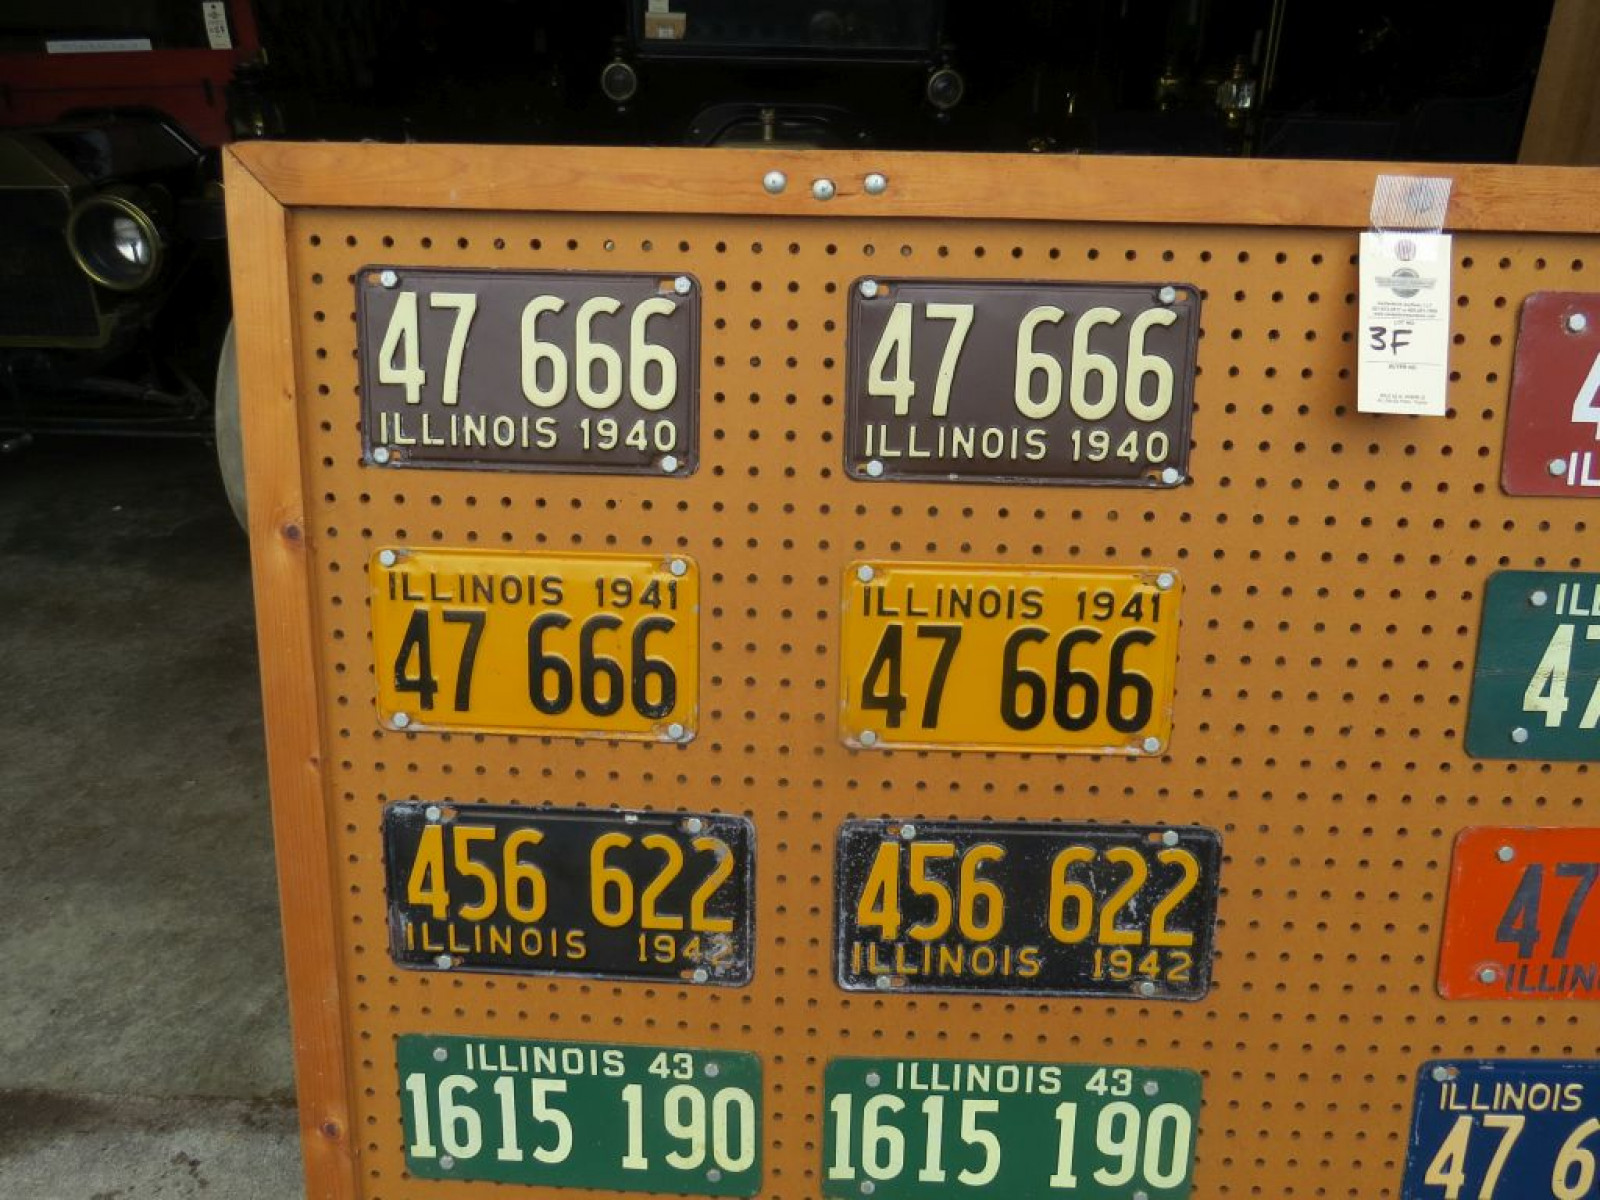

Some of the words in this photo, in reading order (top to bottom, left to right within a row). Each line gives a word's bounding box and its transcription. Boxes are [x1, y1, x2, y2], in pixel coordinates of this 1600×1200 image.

[379, 291, 478, 405] 47
[521, 295, 678, 411] 666
[867, 302, 975, 417] 47
[1014, 305, 1178, 422] 666
[1369, 326, 1413, 356] 3F
[380, 412, 558, 449] ILLINOIS
[580, 417, 678, 452] 1940
[865, 425, 1048, 461] ILLINOIS
[1071, 430, 1170, 464] 1940
[389, 572, 564, 606] ILLINOIS
[595, 578, 678, 610] 1941
[863, 586, 1045, 620] ILLINOIS
[1077, 591, 1160, 622] 1941
[394, 608, 487, 712] 47
[528, 611, 677, 720] 666
[860, 624, 963, 729] 47
[1000, 627, 1157, 733] 666
[407, 824, 548, 924] 456
[590, 832, 735, 933] 622
[857, 841, 1006, 943] 456
[1048, 845, 1200, 947] 622
[1495, 862, 1600, 960] 47
[406, 922, 587, 960] ILLINOIS
[638, 933, 734, 967] 1942
[852, 942, 1041, 978] ILLINOIS
[1092, 948, 1194, 982] 1942
[1505, 963, 1600, 994] ILLIN
[465, 1043, 625, 1078] ILLINOIS
[648, 1052, 694, 1080] 43
[896, 1062, 1062, 1095] ILLINOIS
[1085, 1068, 1133, 1097] 43
[1440, 1082, 1584, 1112] ILLINOIS
[405, 1072, 573, 1164] 1615
[621, 1083, 756, 1173] 190
[828, 1093, 1001, 1187] 1615
[1049, 1101, 1193, 1189] 190
[1424, 1114, 1526, 1200] 47
